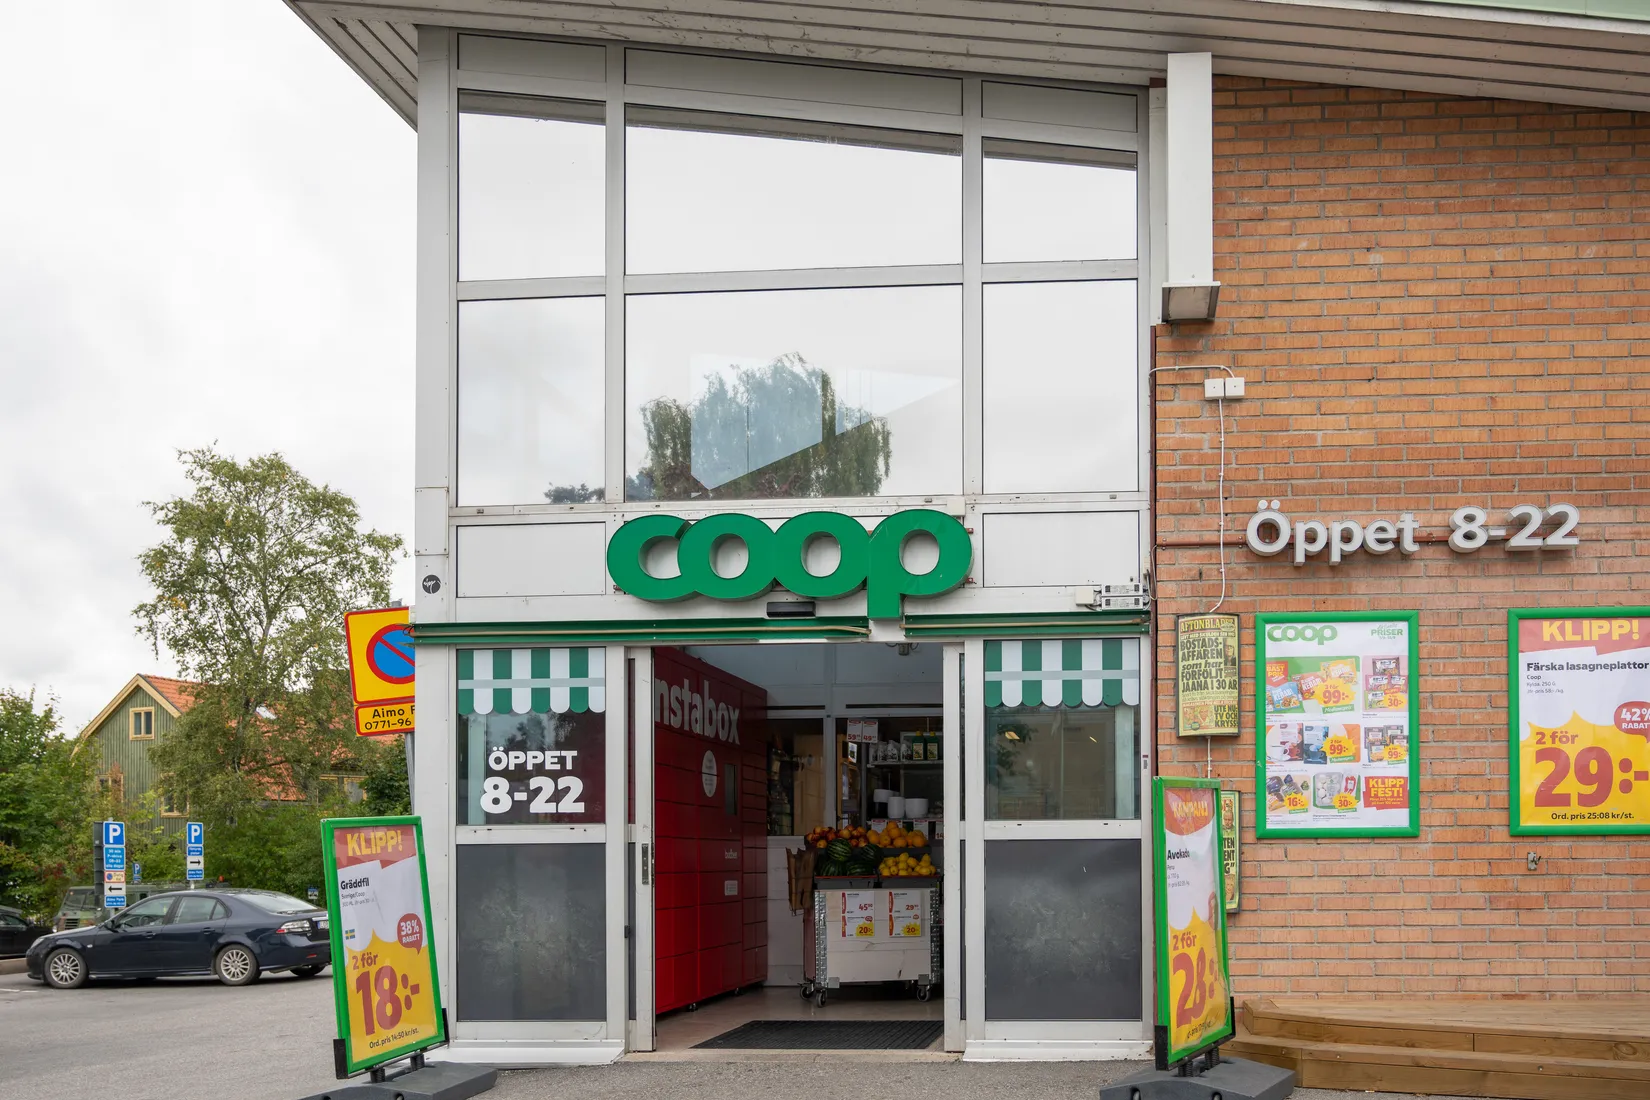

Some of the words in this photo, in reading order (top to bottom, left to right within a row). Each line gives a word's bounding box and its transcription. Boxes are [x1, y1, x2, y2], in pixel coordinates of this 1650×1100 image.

[1246, 499, 1420, 566] Öppet
[1448, 502, 1580, 553] 8-22
[606, 508, 973, 619] coop
[1267, 625, 1338, 646] coop
[1371, 628, 1403, 636] PRISER
[1542, 619, 1639, 642] KLIPP!
[1181, 638, 1222, 652] BOSTADS-
[1181, 647, 1223, 662] AFFÄREN
[1182, 662, 1202, 671] som
[1204, 660, 1223, 668] har
[1527, 662, 1565, 672] Färska
[1566, 660, 1650, 673] lasagneplattor
[1181, 668, 1223, 682] FÖRFÖLJT
[1181, 680, 1209, 693] JAANA
[1216, 679, 1226, 690] 30
[1322, 690, 1349, 704] 99:-
[372, 708, 405, 719] Aimo
[654, 678, 740, 745] nstabox
[364, 718, 412, 730] 0771-96
[1536, 732, 1546, 745] 2
[1550, 730, 1578, 745] för
[1329, 744, 1349, 755] 99:-
[488, 746, 578, 771] ÖPPET
[1369, 778, 1404, 788] KLIPP
[1534, 746, 1650, 808] 29:-
[480, 776, 585, 814] 8-22
[1370, 788, 1402, 796] FEST!
[1551, 812, 1569, 820] Ord.
[1570, 812, 1586, 822] pris
[1587, 812, 1610, 820] 25:08
[1611, 812, 1635, 820] kr/st.
[109, 824, 121, 844] P
[191, 824, 200, 843] P
[346, 830, 403, 857] KLIPP!
[1167, 848, 1190, 860] Avokado
[340, 877, 370, 890] Gräddfil
[400, 920, 420, 935] 38%
[402, 934, 420, 943] RABATT
[1172, 934, 1179, 951] 2
[1180, 932, 1197, 948] för
[352, 956, 359, 970] 2
[360, 952, 378, 968] för
[356, 965, 420, 1036] 18:-
[369, 1040, 381, 1048] Ord.
[381, 1037, 391, 1046] pris
[404, 1027, 419, 1038] kr/st.
